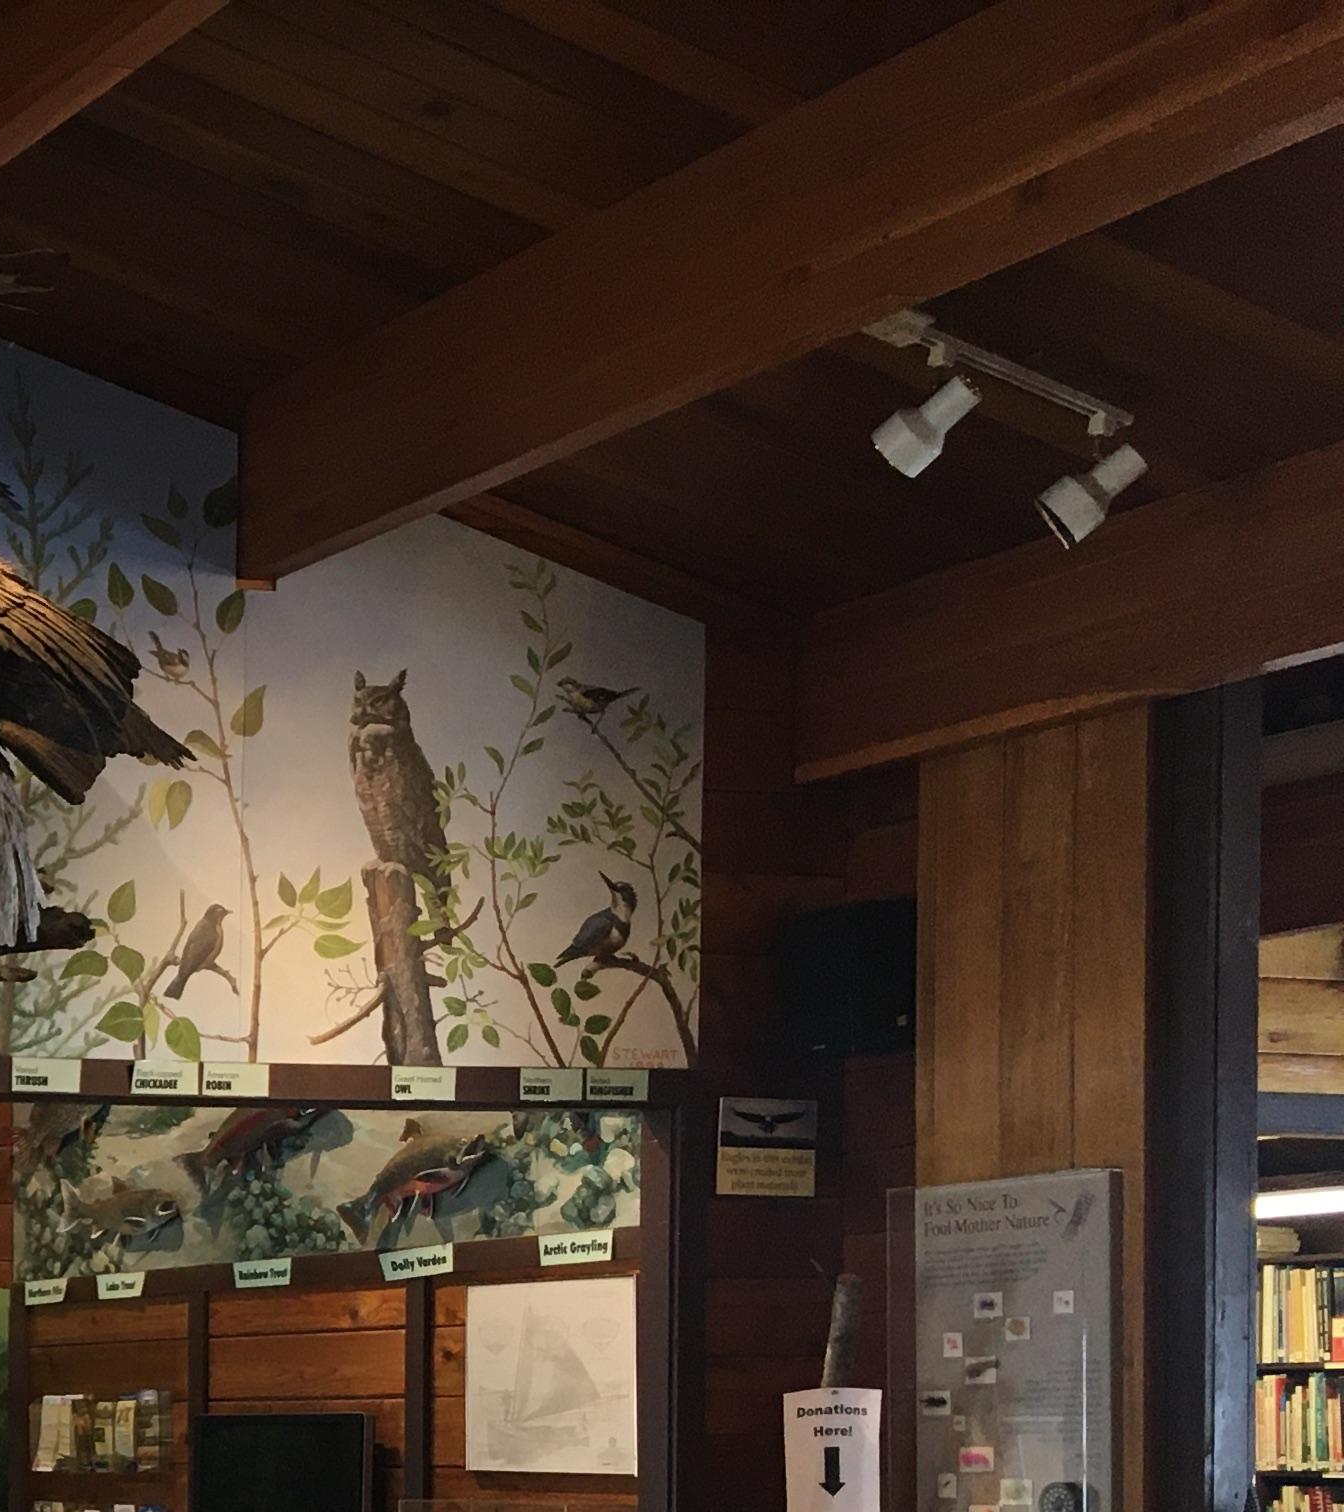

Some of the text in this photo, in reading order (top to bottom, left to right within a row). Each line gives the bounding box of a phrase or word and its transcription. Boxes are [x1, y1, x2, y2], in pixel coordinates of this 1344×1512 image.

[611, 1047, 679, 1060] STEWART
[15, 1076, 48, 1086] THRUSH
[135, 1079, 178, 1089] CHICKADEE
[206, 1081, 232, 1090] ROBIN
[395, 1084, 412, 1094] OWL
[944, 1199, 961, 1214] So
[967, 1197, 997, 1211] Nice
[1002, 1194, 1018, 1209] To
[924, 1214, 1050, 1237] Fool Mother Nature
[543, 1240, 608, 1256] Arctic Grayling
[391, 1254, 447, 1272] Dolly Varden
[796, 1404, 868, 1418] Donations
[814, 1426, 852, 1437] Here!
